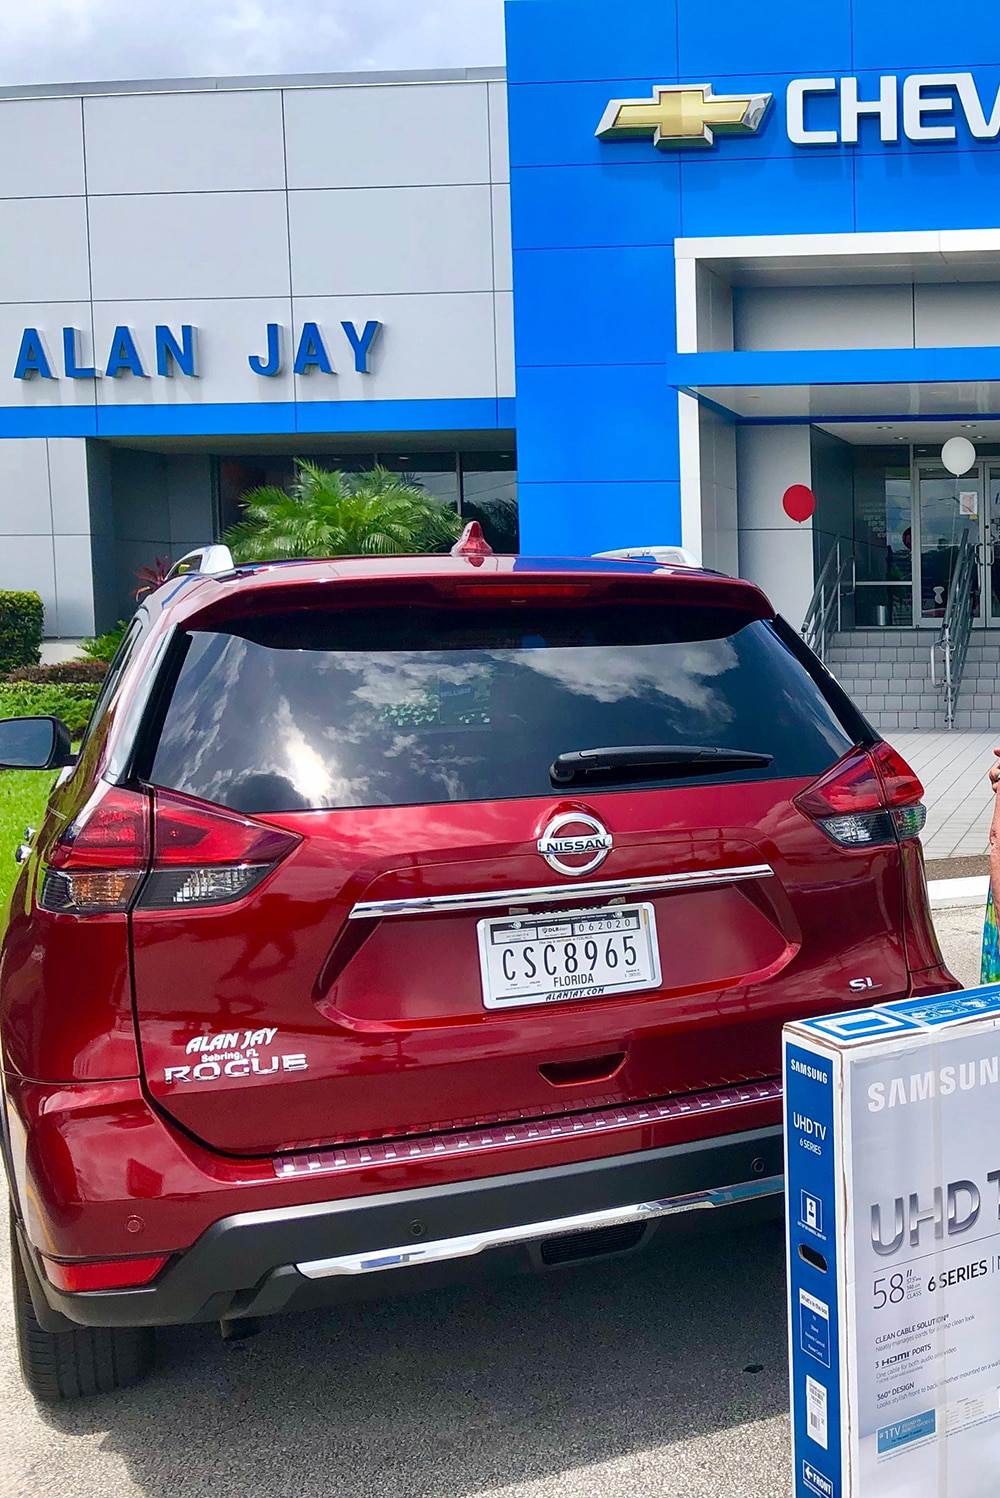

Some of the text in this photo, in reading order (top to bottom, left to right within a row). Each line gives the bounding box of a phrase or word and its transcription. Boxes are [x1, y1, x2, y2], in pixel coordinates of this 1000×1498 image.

[13, 319, 383, 380] ALAN JAY
[546, 838, 607, 853] NISSAN
[502, 935, 637, 981] CSC8965
[553, 973, 594, 988] FLORIDA
[849, 976, 883, 994] SL
[185, 1027, 279, 1055] ALAN JAY
[245, 1048, 260, 1058] FL
[163, 1053, 310, 1085] ROGUE
[790, 1058, 828, 1084] SAMSUNG
[938, 1259, 988, 1289] SERIES
[875, 1331, 896, 1344] CLEAN
[896, 1324, 917, 1338] CABLE
[911, 1343, 932, 1356] PORTS
[891, 1381, 916, 1396] DESIGN
[813, 1473, 832, 1495] FRONT
